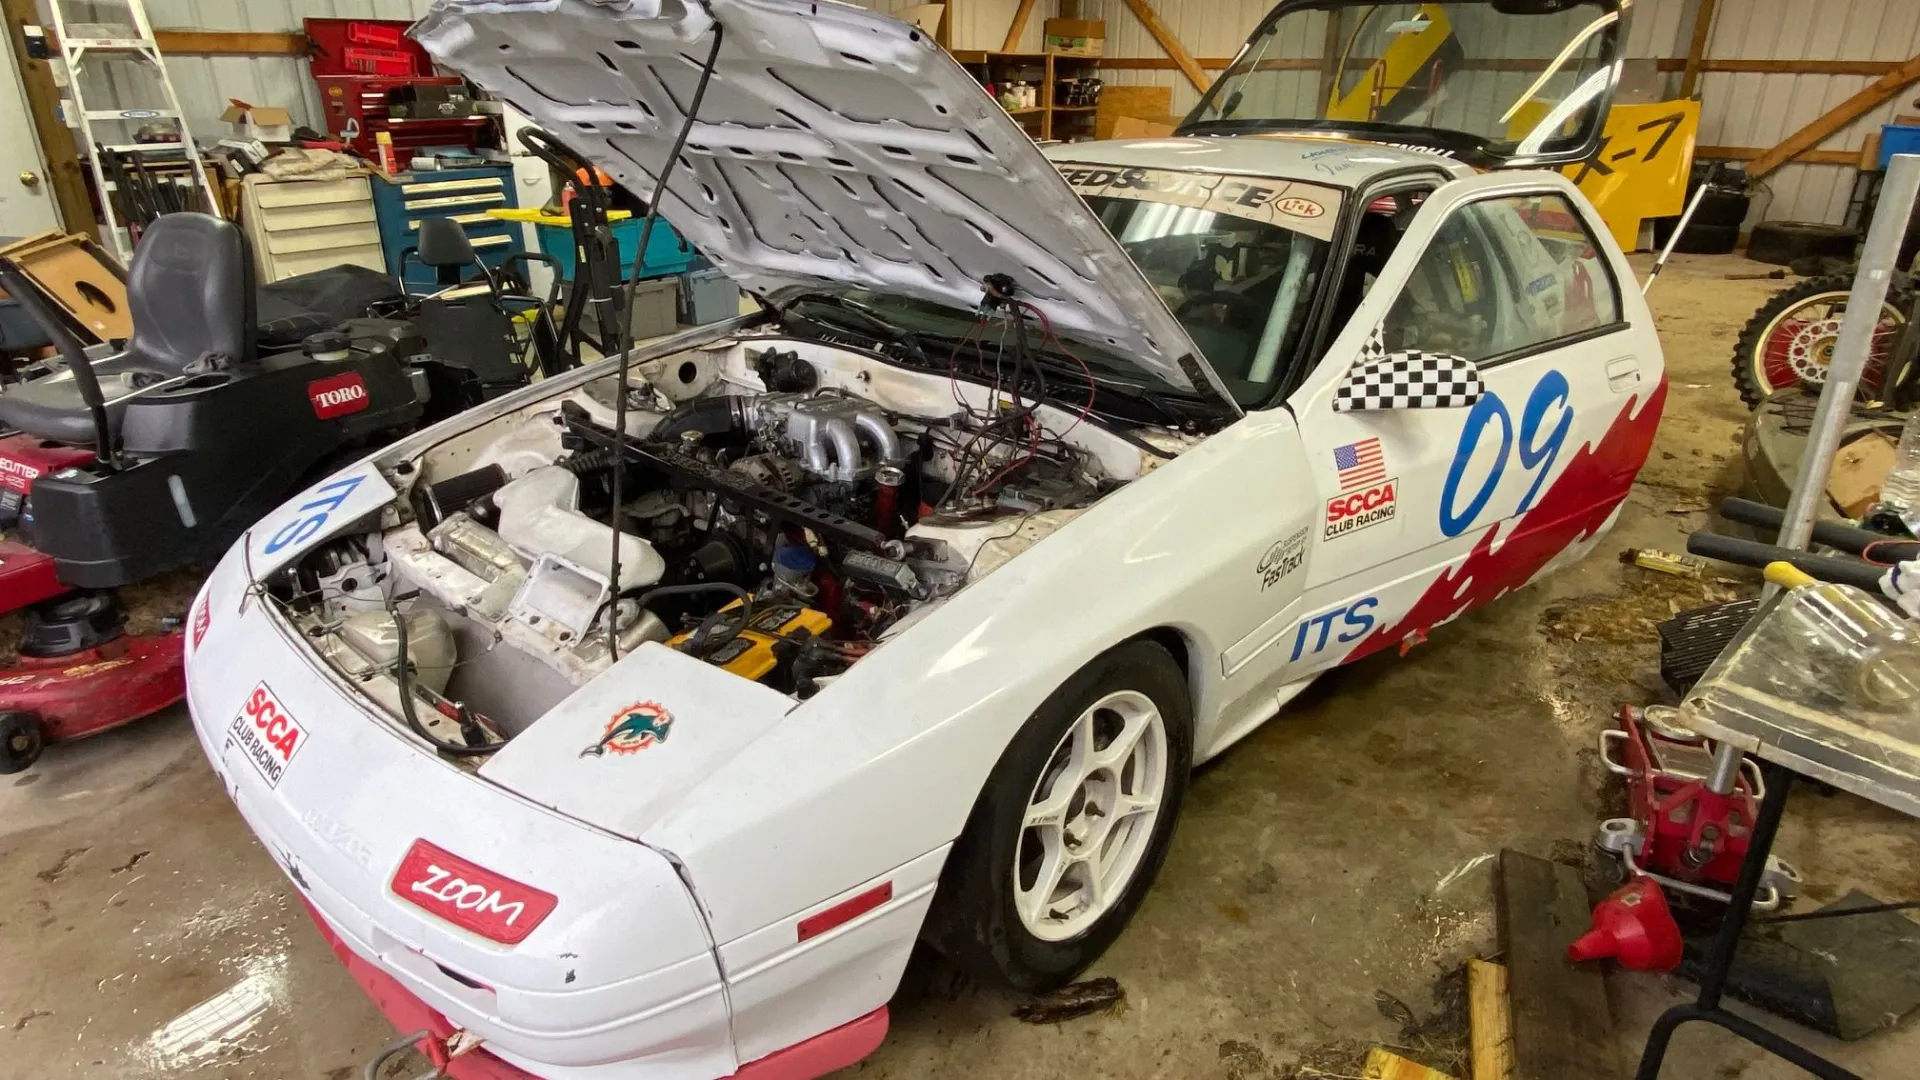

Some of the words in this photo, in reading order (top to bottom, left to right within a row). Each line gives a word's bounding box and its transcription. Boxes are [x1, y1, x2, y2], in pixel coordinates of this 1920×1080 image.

[1560, 111, 1685, 187] X-7
[315, 384, 363, 408] TORO
[1439, 369, 1573, 537] 09
[263, 474, 368, 555] ITS
[1326, 518, 1354, 537] CLUB
[1355, 505, 1394, 528] RACING
[1327, 483, 1395, 522] SCCA
[1289, 596, 1379, 663] ITS
[232, 715, 255, 747] CLUB
[248, 736, 282, 782] RACING
[245, 687, 300, 762] SCCA
[411, 864, 525, 926] ZOOM
